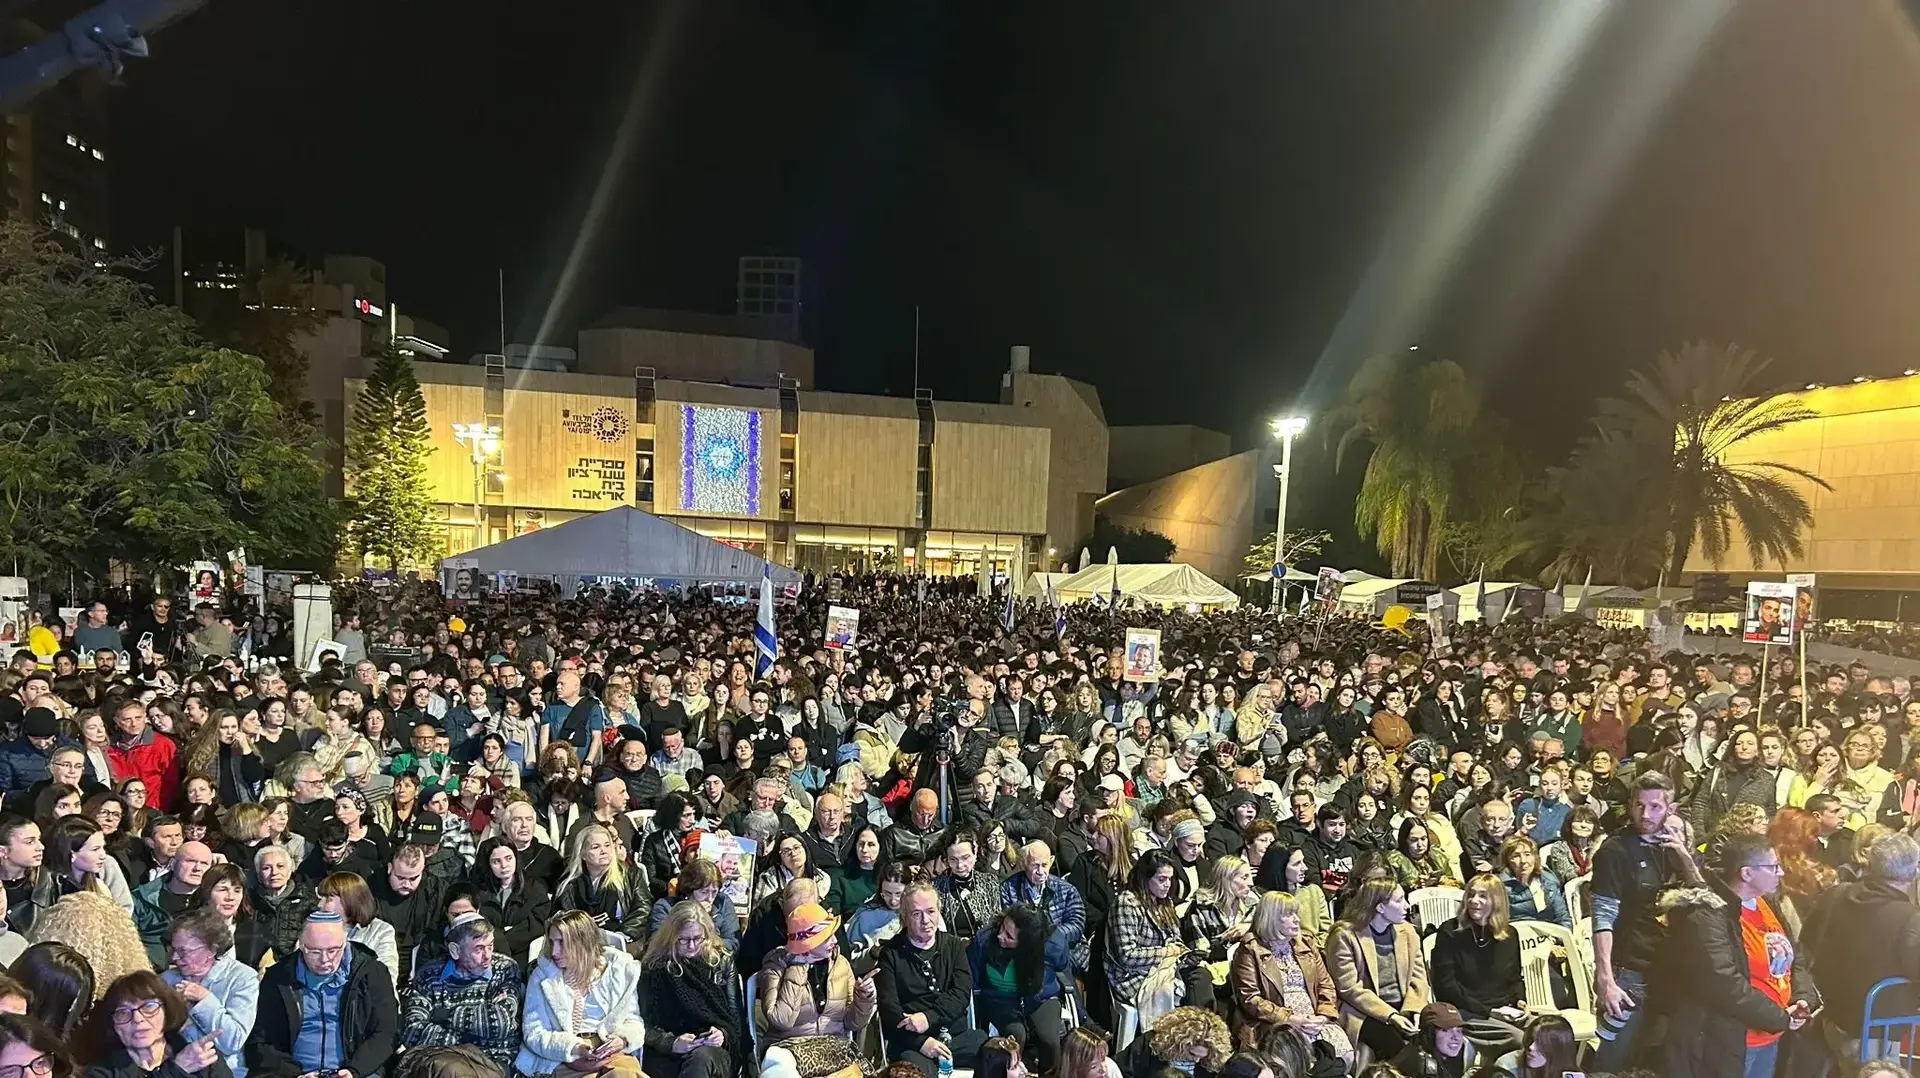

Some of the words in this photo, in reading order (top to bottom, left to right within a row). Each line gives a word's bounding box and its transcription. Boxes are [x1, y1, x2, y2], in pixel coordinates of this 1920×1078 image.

[578, 457, 625, 469] ספריית
[602, 480, 625, 491] בית
[572, 489, 625, 501] אריאלה
